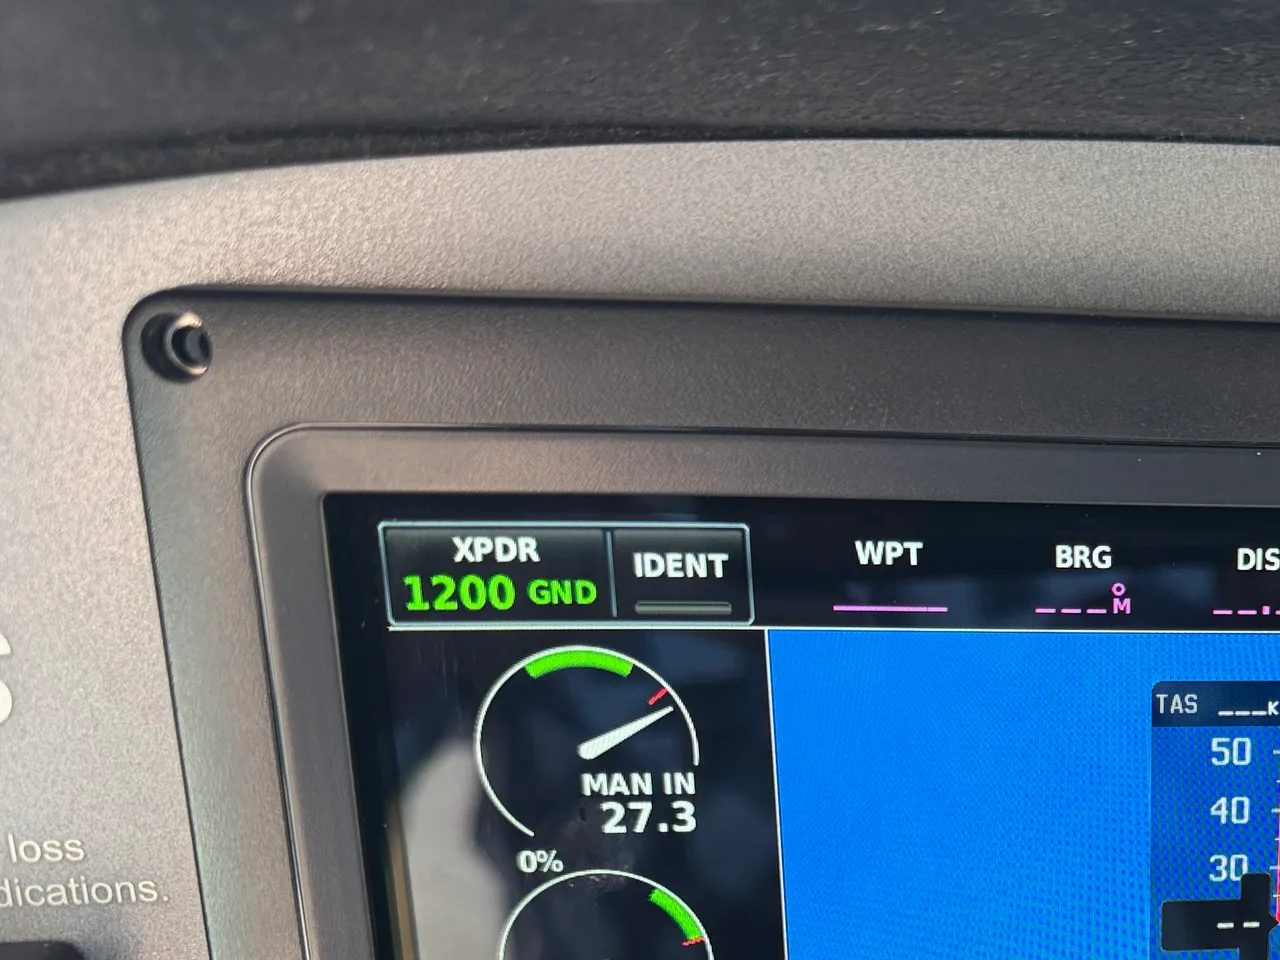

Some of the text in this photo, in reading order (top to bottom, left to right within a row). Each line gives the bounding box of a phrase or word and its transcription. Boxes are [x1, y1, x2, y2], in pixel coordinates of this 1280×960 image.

[452, 536, 540, 563] XPDR
[855, 541, 923, 566] WPT
[1055, 545, 1112, 569] BRG
[633, 552, 729, 579] IDENT
[403, 574, 597, 611] 1200 GND
[1156, 694, 1198, 714] TAS
[1211, 738, 1251, 766] 50
[581, 772, 696, 796] MAN IN
[600, 801, 697, 833] 27.3
[1210, 796, 1250, 825] 40
[8, 833, 85, 864] loss
[516, 850, 564, 873] 0%
[1209, 854, 1249, 882] 30
